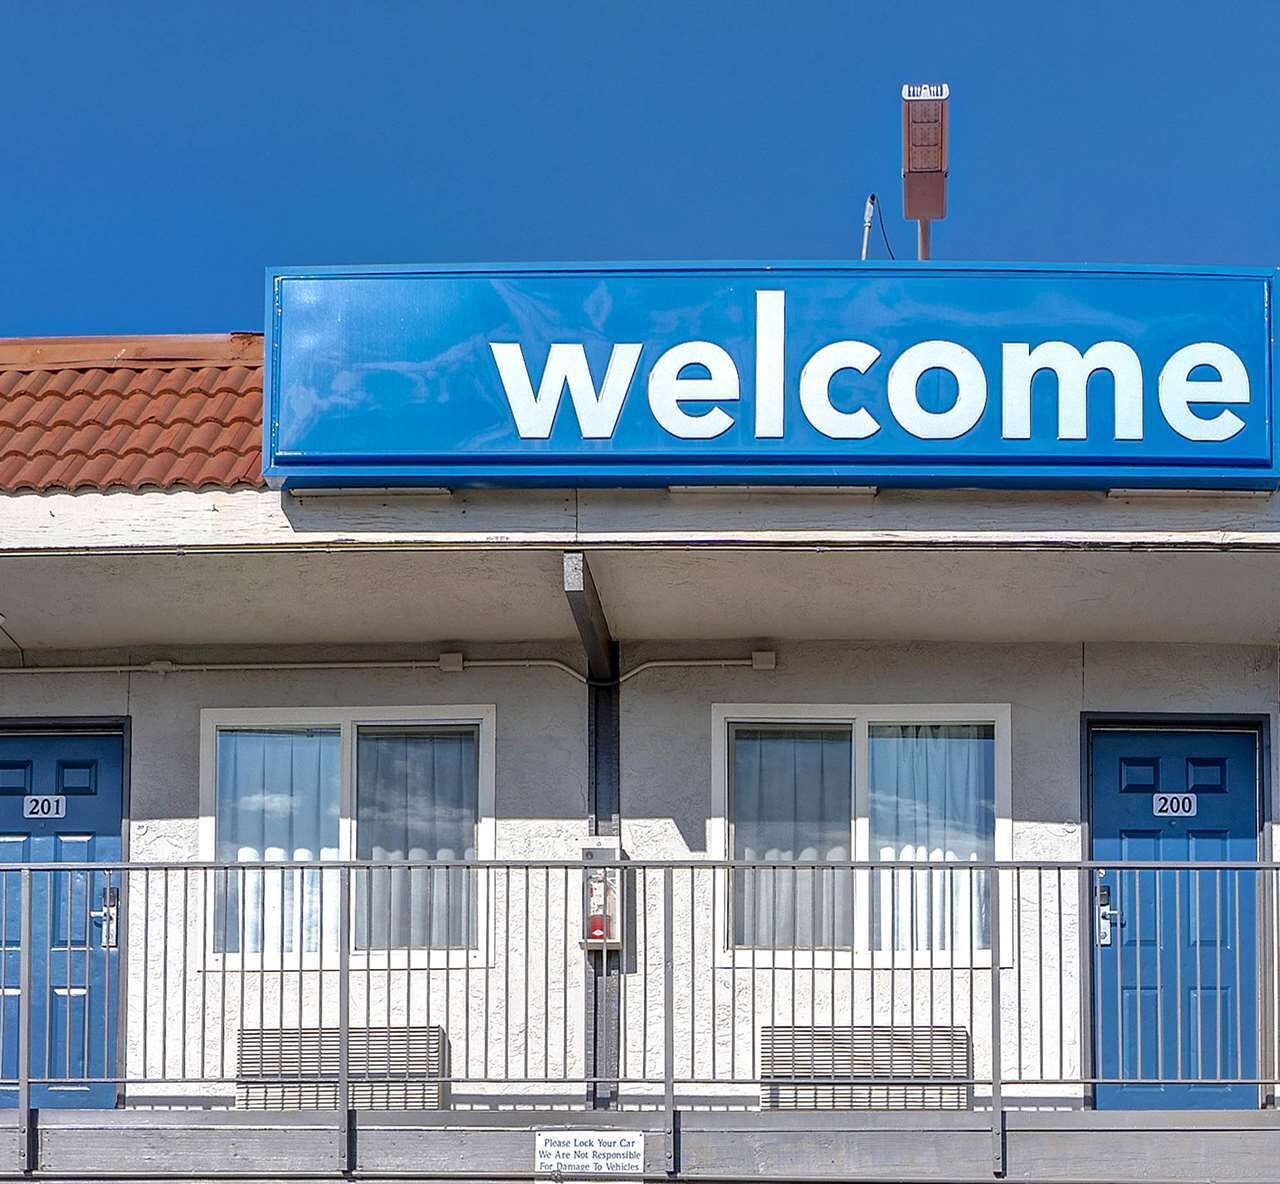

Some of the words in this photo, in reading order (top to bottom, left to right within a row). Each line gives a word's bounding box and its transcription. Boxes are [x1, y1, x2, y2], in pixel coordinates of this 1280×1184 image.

[489, 289, 1252, 442] welcome
[29, 798, 61, 815] 201
[1158, 796, 1192, 813] 200
[544, 1138, 571, 1147] Please
[573, 1138, 593, 1147] Lock
[597, 1138, 617, 1147] Your
[619, 1138, 635, 1147] Car
[538, 1150, 551, 1159] We
[554, 1150, 570, 1159] Are
[573, 1150, 588, 1159] Not
[591, 1150, 641, 1161] Responsible
[539, 1161, 552, 1170] For
[556, 1161, 590, 1172] Damage
[592, 1161, 602, 1170] To
[605, 1161, 639, 1171] Vehicles
